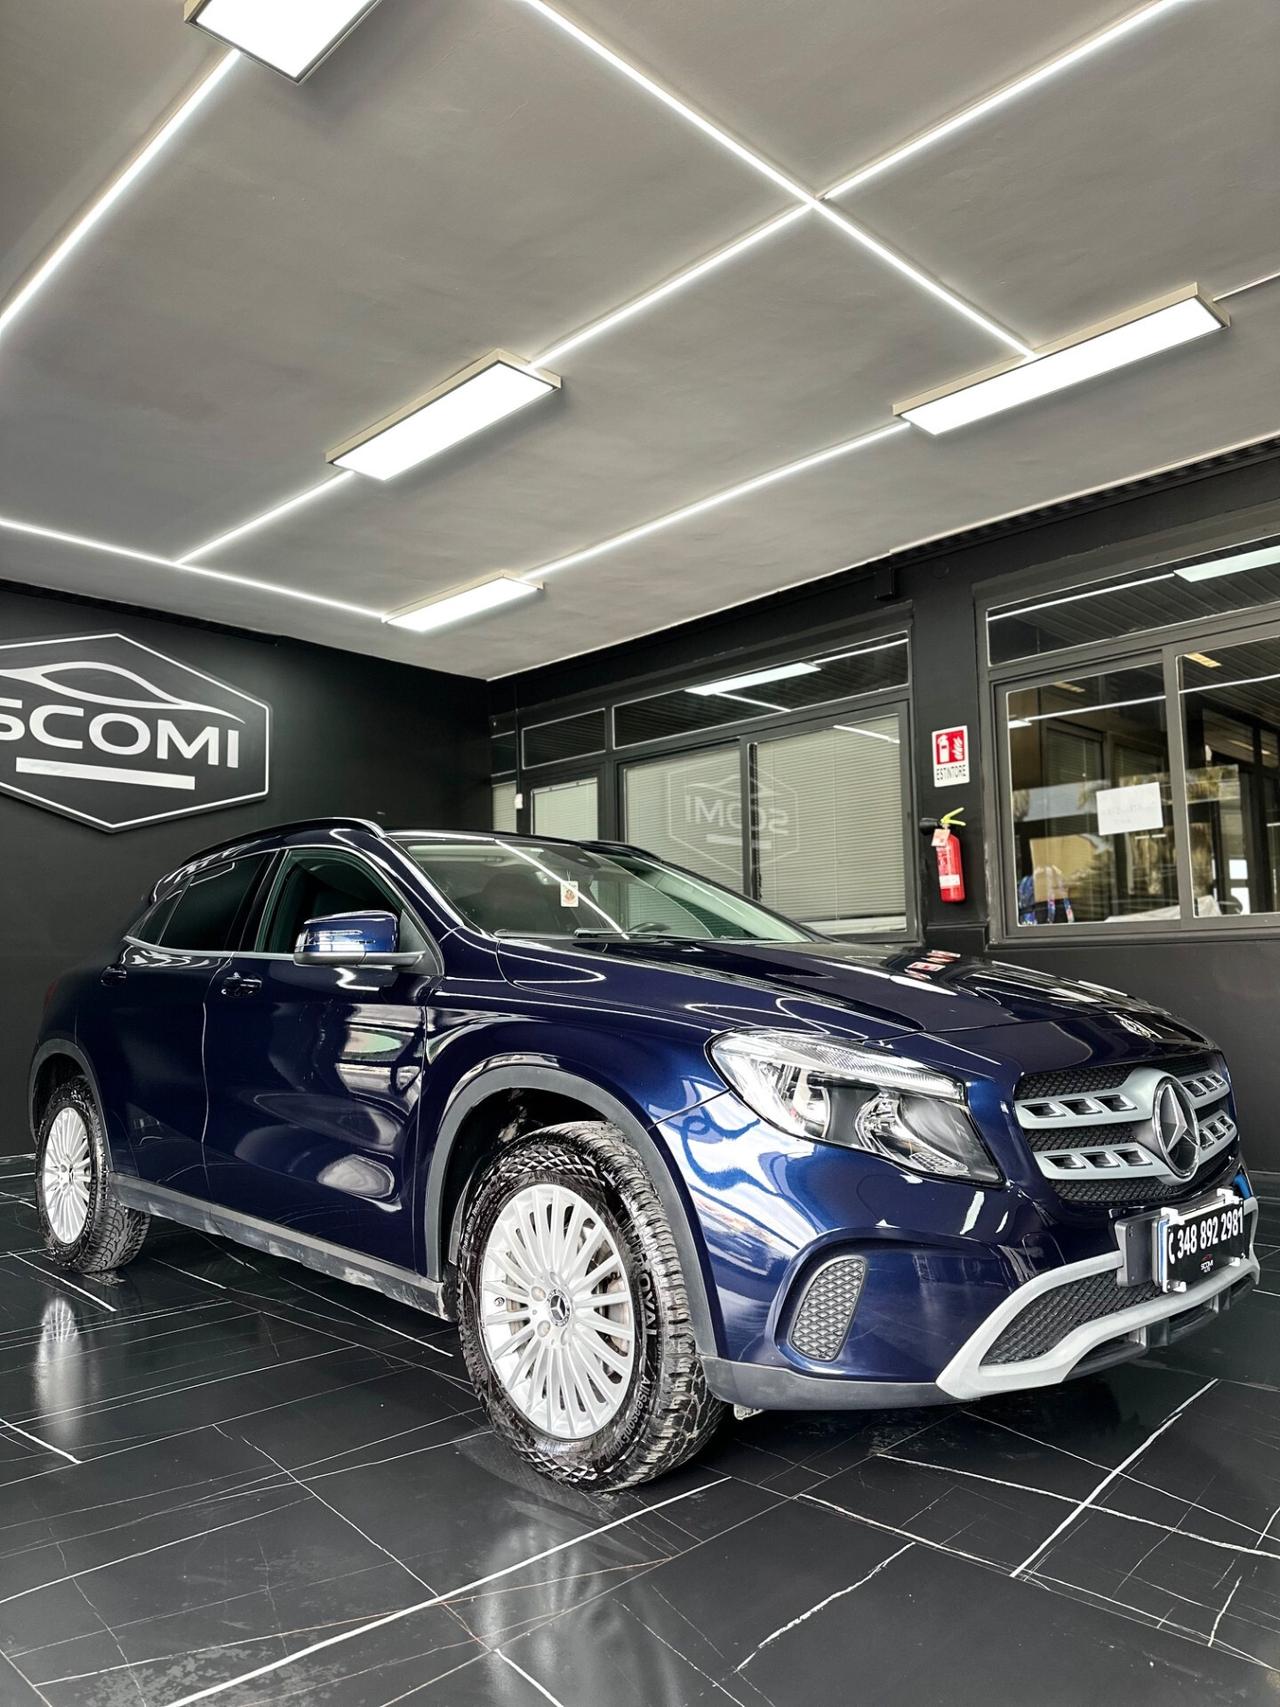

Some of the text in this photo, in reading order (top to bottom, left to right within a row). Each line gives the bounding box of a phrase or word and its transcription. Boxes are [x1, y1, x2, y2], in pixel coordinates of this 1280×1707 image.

[1177, 1208, 1243, 1258] 348 892 2981
